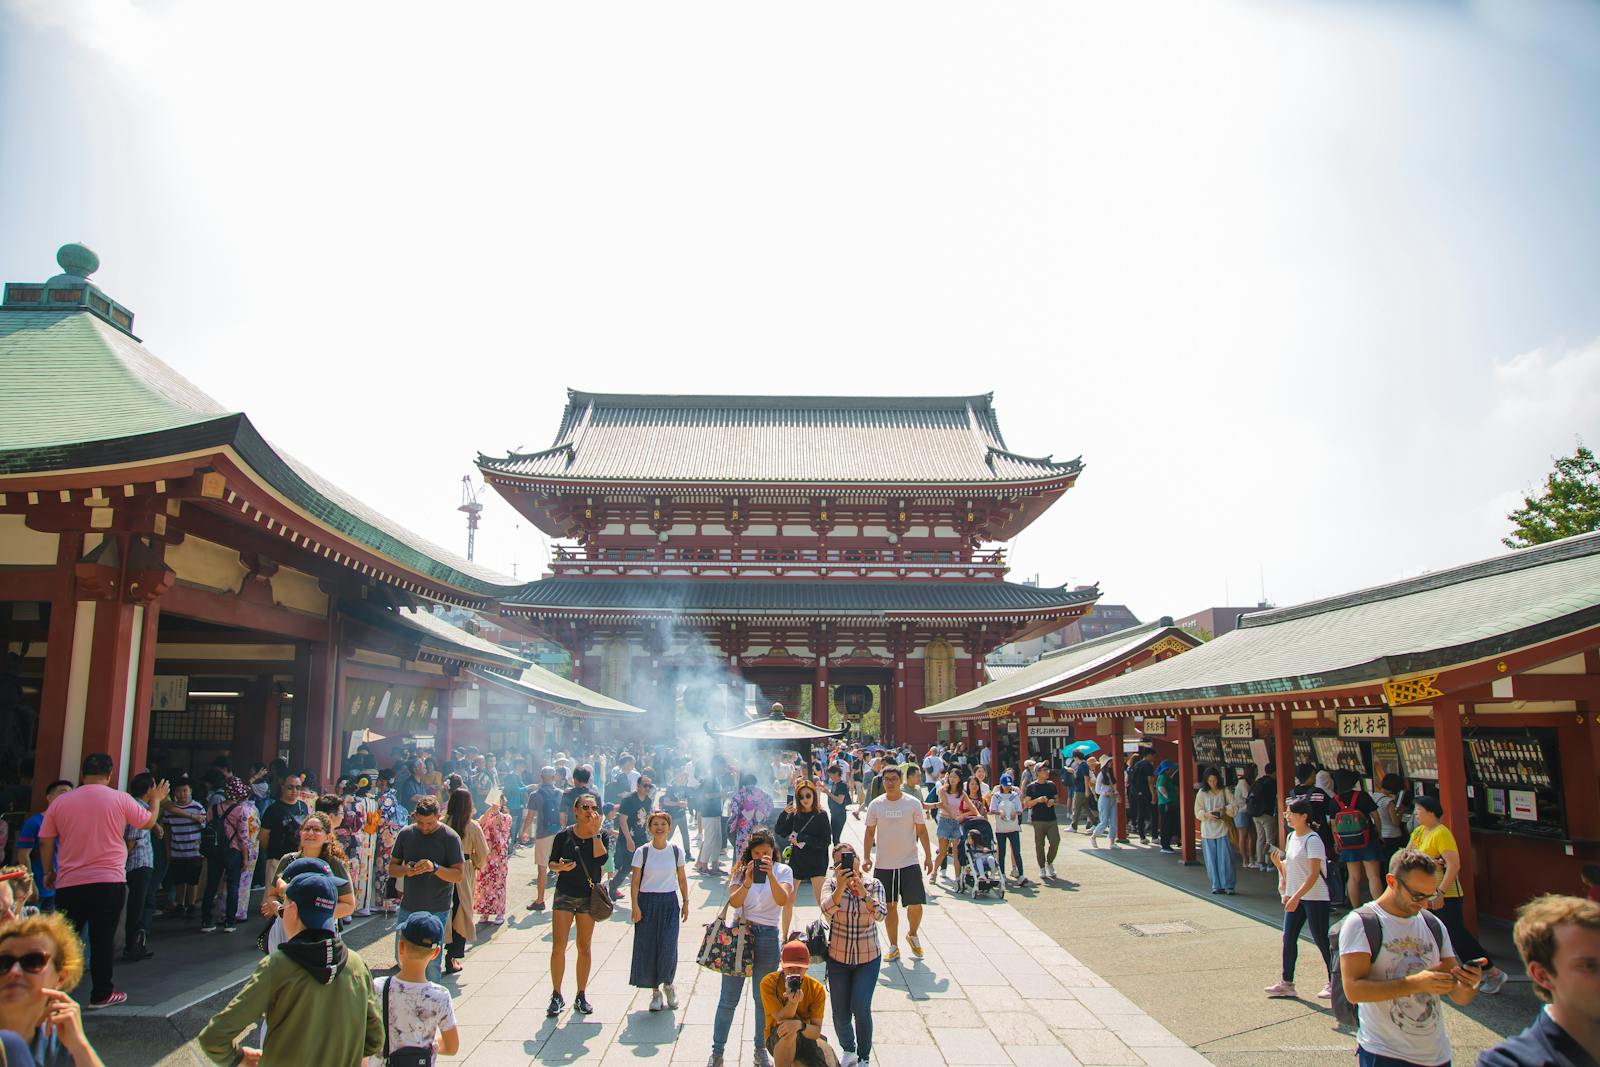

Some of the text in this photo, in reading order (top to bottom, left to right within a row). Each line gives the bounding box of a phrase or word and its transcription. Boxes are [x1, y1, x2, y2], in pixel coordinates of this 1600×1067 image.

[1224, 720, 1252, 736] お札お守
[1343, 715, 1387, 735] お札お守
